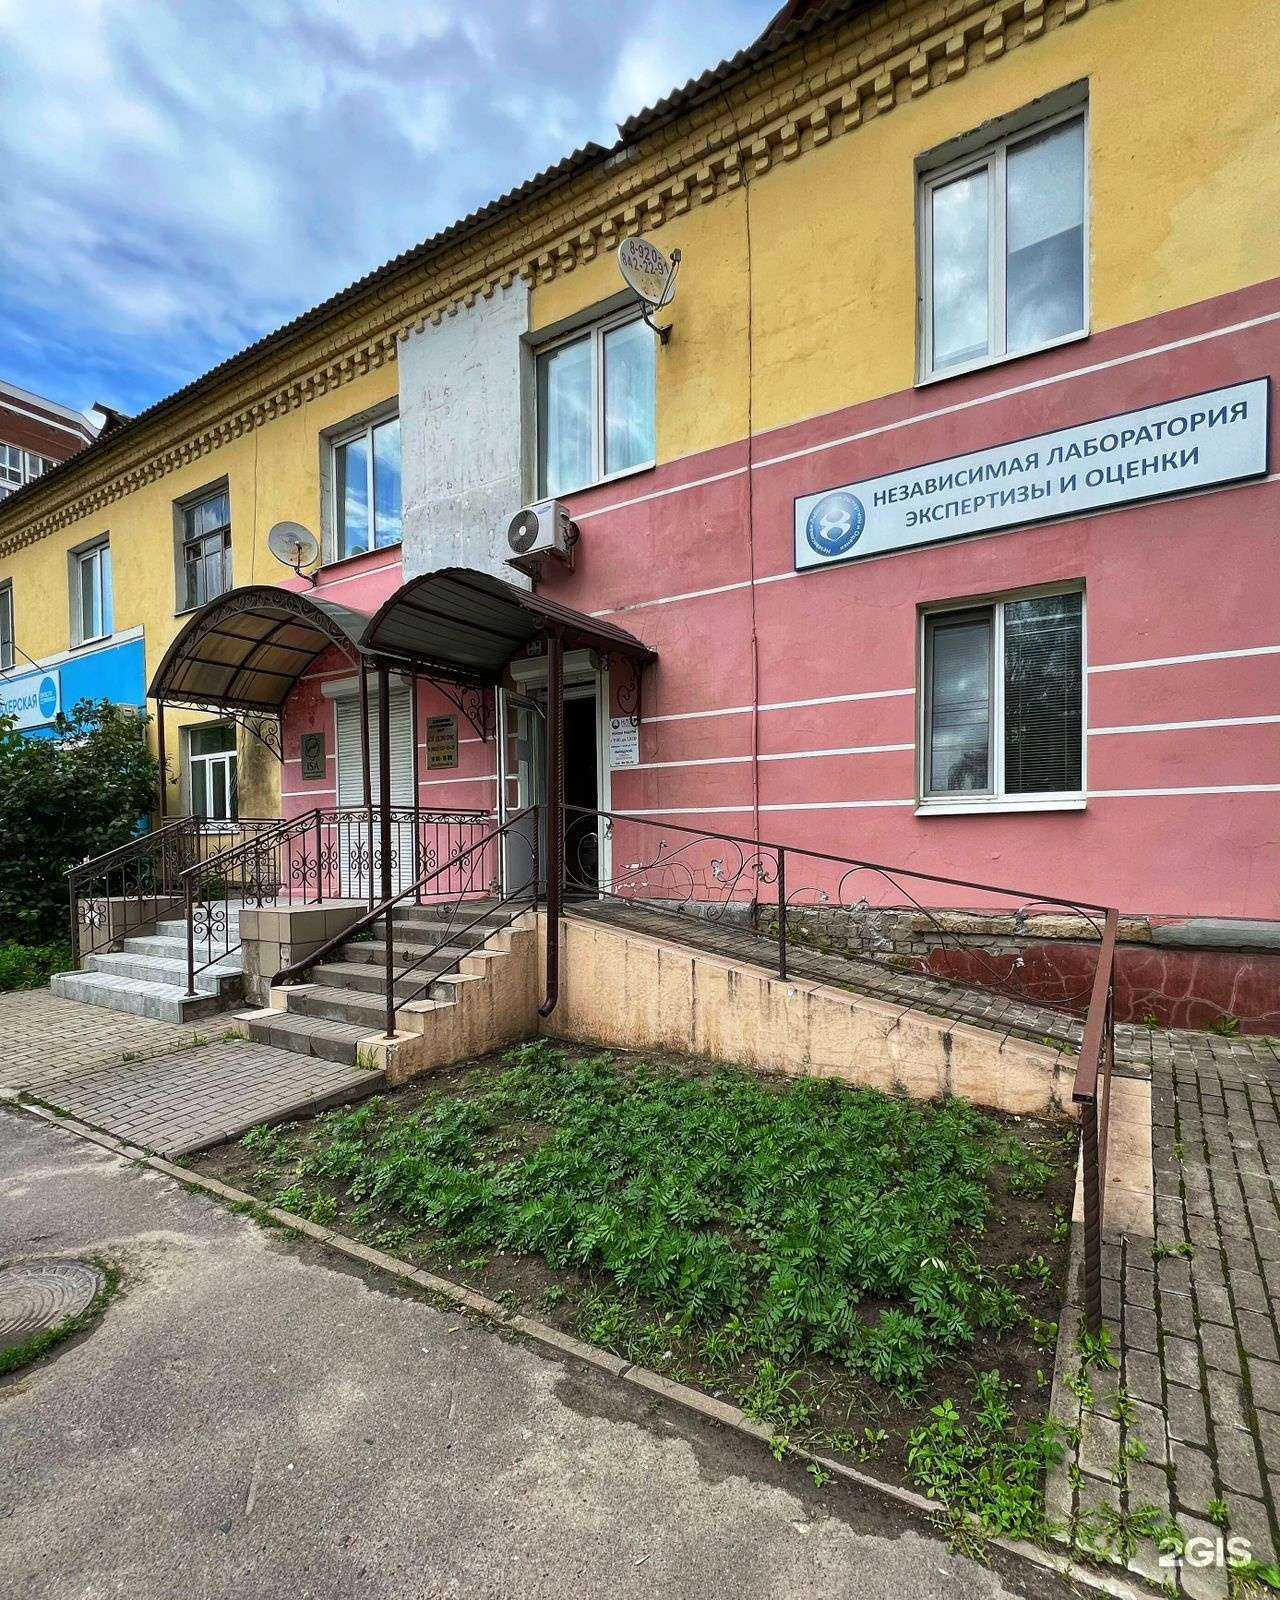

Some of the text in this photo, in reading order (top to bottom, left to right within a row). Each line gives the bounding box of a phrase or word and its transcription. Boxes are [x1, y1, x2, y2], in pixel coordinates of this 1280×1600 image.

[872, 401, 1248, 508] НЕЗАВИСИМАЯ ЛАБОРАТОРИЯ
[905, 481, 1051, 528] ЭКСПЕРТИЗЫ
[1060, 474, 1077, 494] И
[1085, 446, 1200, 488] ОЦЕНКИ
